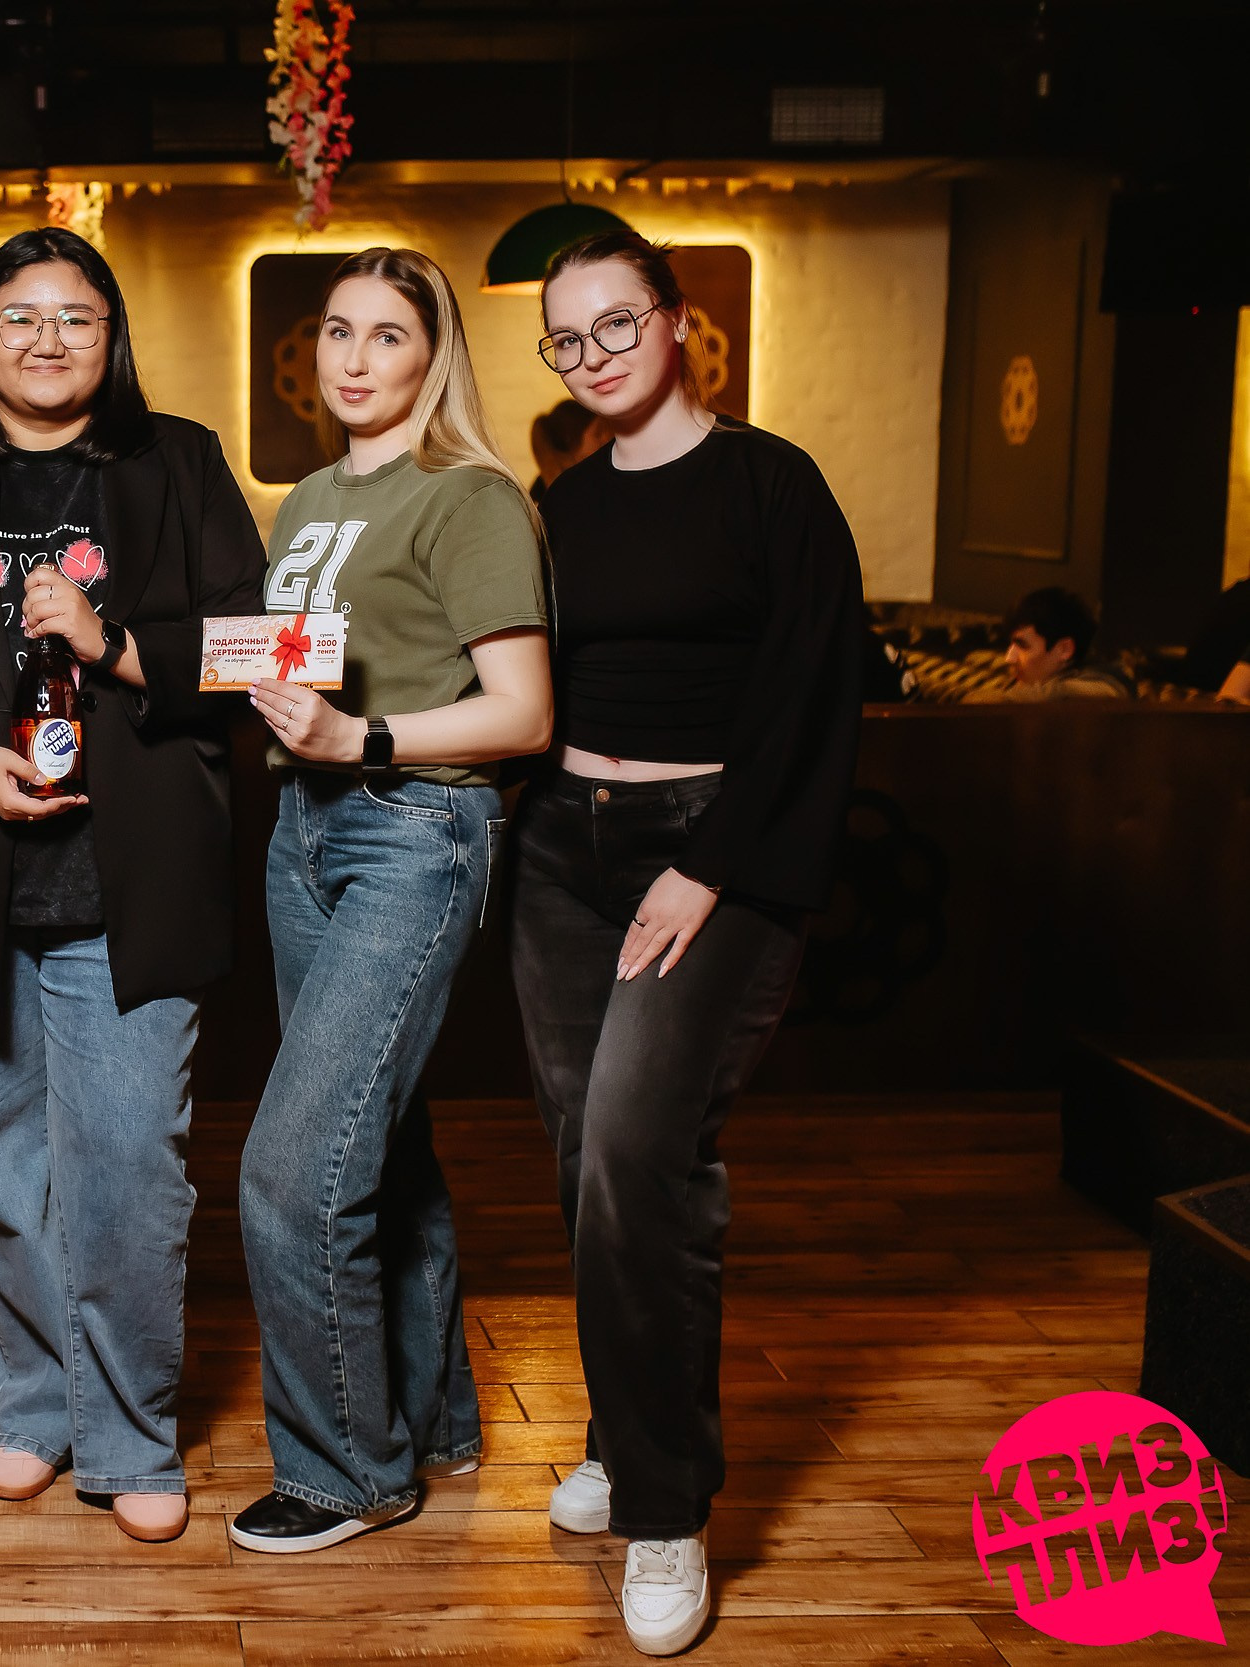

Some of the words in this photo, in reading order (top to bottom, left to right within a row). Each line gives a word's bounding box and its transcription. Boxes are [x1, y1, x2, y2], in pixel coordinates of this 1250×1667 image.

[46, 523, 90, 539] yourself
[265, 520, 369, 614] 21
[209, 635, 270, 648] ПОДАРОЧНЫЙ
[316, 639, 337, 647] 2000
[211, 648, 267, 657] СЕРТИФИКАТ
